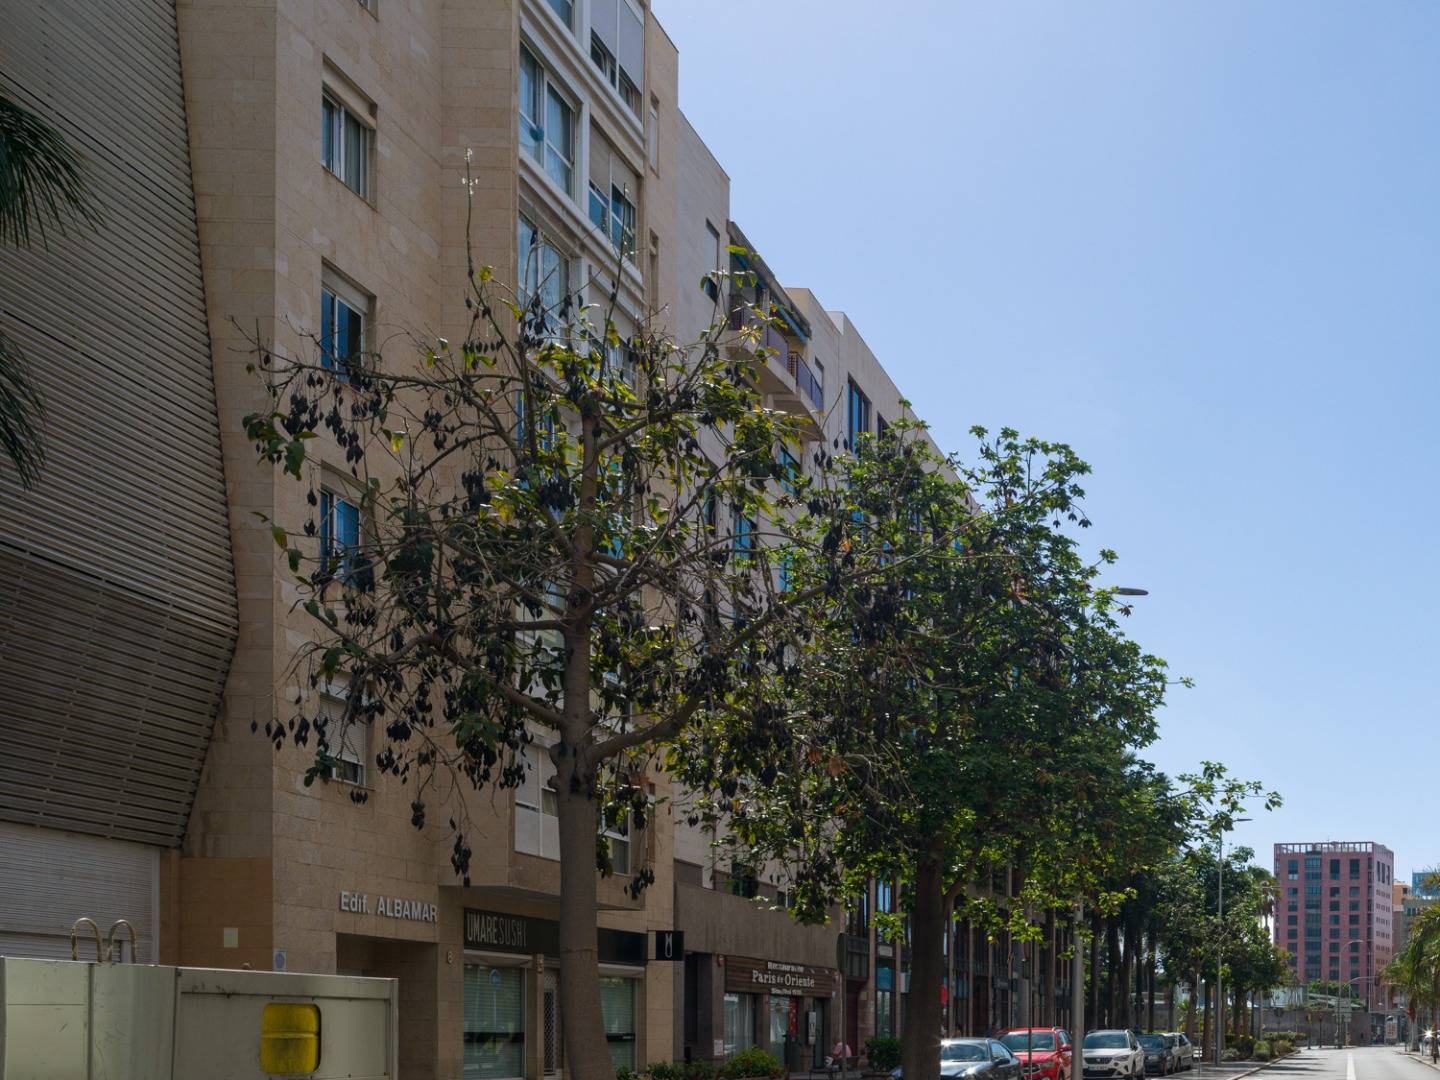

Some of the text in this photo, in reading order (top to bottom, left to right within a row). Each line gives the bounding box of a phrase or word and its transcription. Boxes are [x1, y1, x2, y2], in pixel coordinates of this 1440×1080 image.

[340, 890, 438, 923] Edif. ALBAMAR
[752, 970, 777, 984] Paris
[784, 973, 815, 988] Oriente
